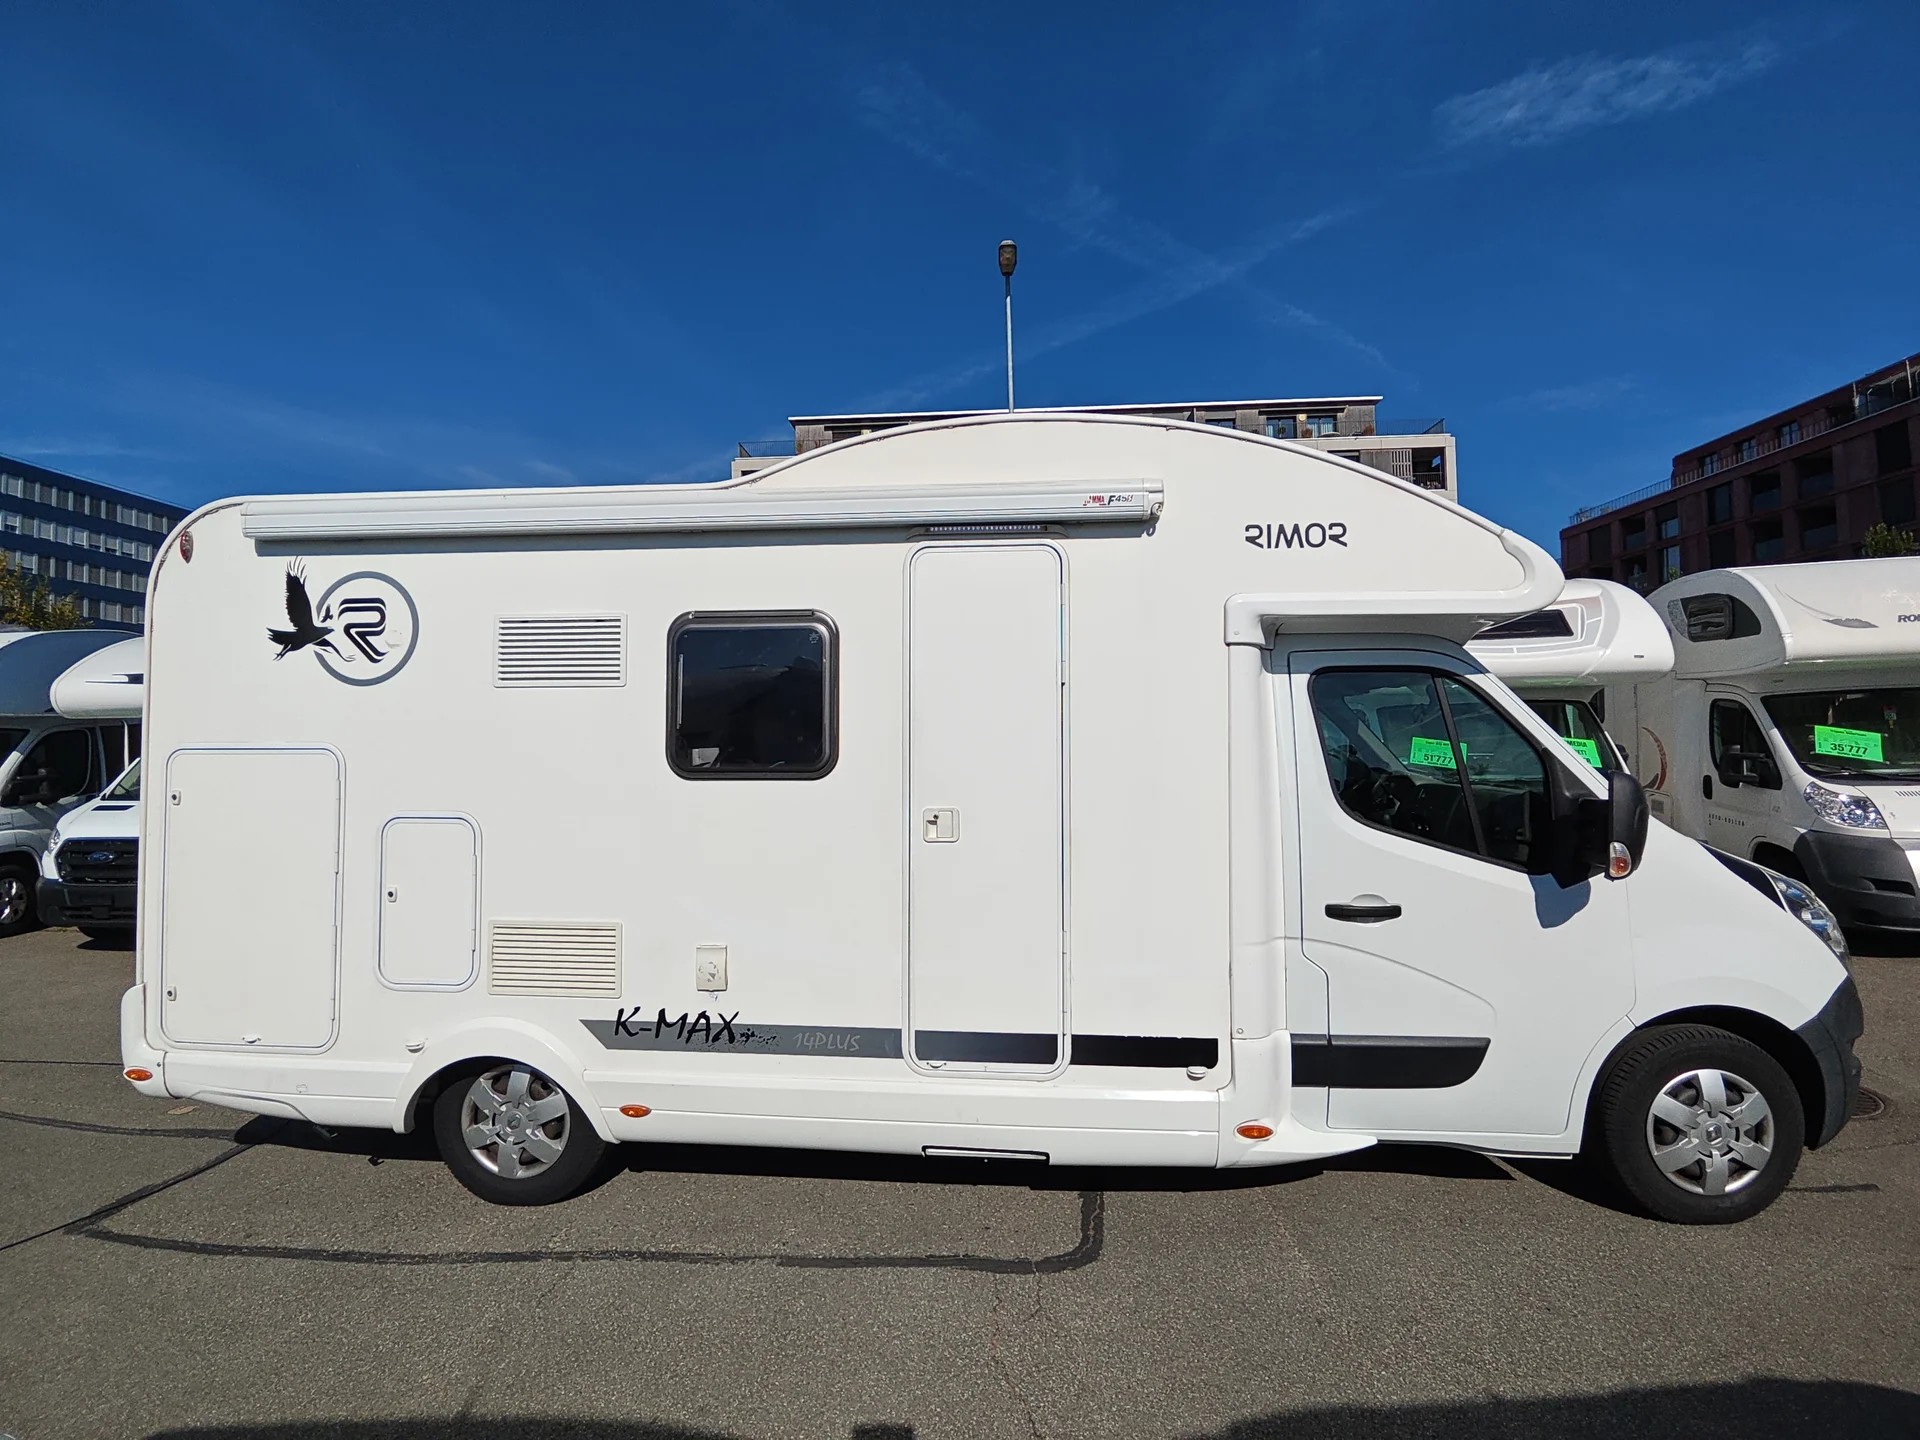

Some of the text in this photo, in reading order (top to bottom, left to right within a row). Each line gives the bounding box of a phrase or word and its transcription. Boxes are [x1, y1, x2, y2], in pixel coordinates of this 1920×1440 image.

[1245, 522, 1347, 549] RIMOR
[1830, 742, 1868, 755] 35'777
[1423, 753, 1454, 765] 51'777
[613, 1006, 740, 1044] K-MAX
